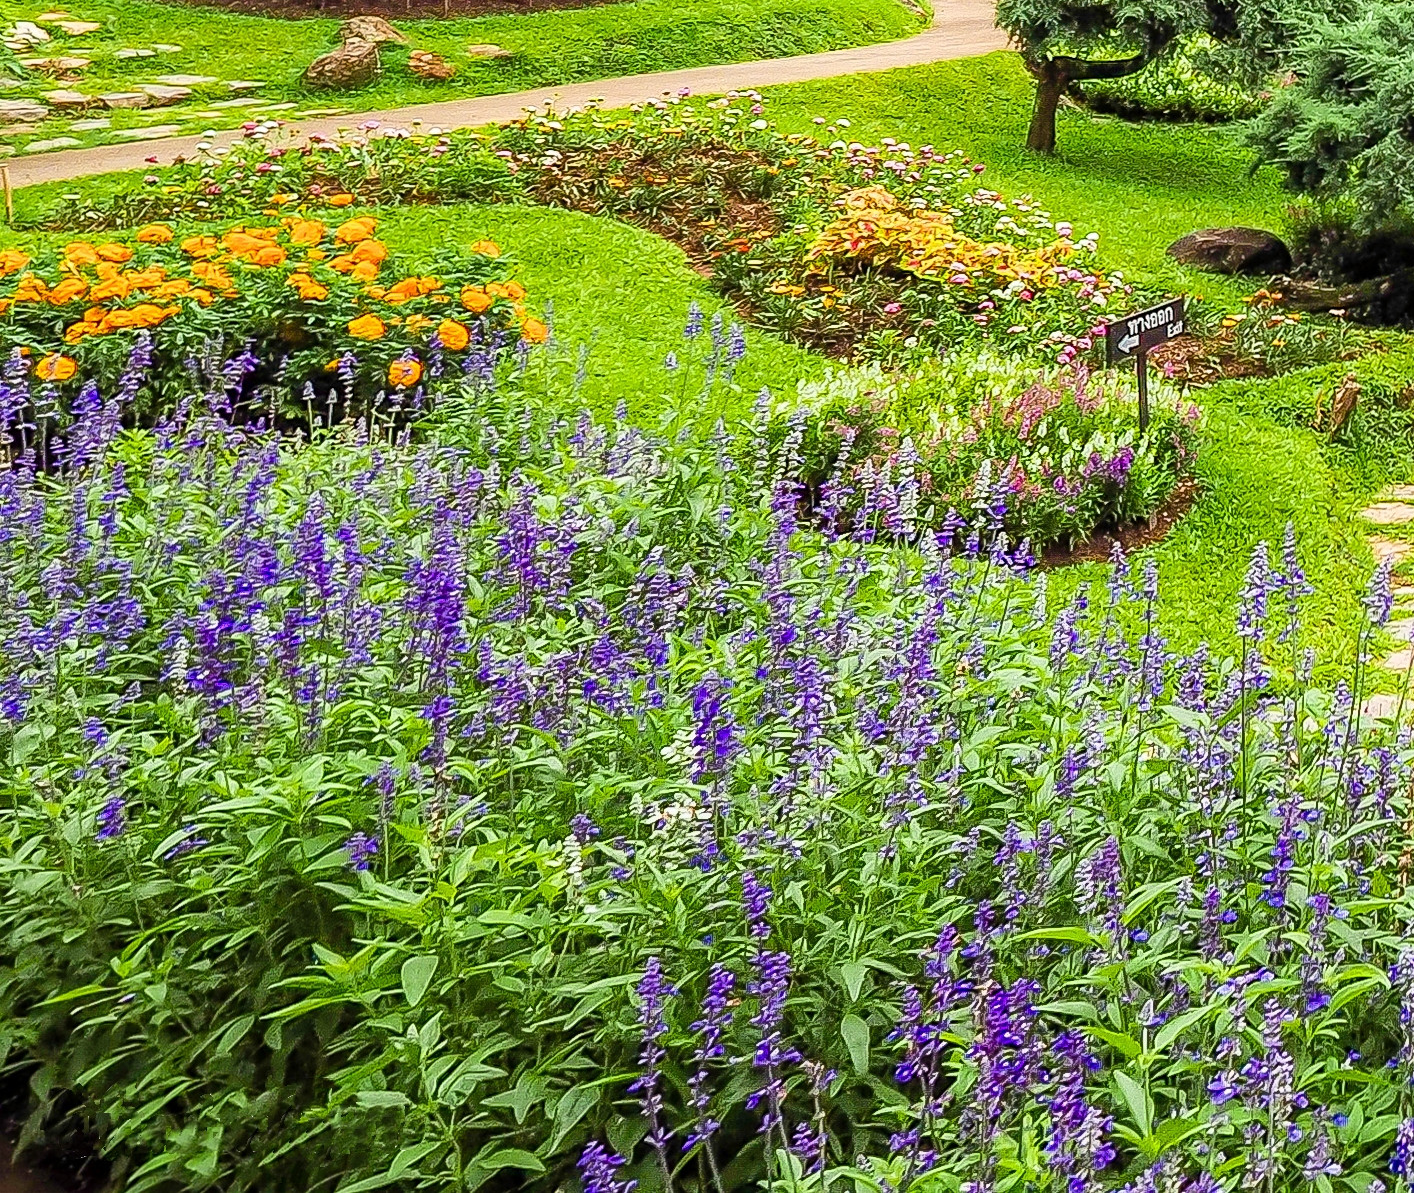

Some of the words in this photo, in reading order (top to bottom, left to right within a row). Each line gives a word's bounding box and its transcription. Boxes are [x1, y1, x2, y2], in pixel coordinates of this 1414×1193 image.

[1127, 306, 1174, 335] ทางออก
[1167, 320, 1184, 338] Exit
